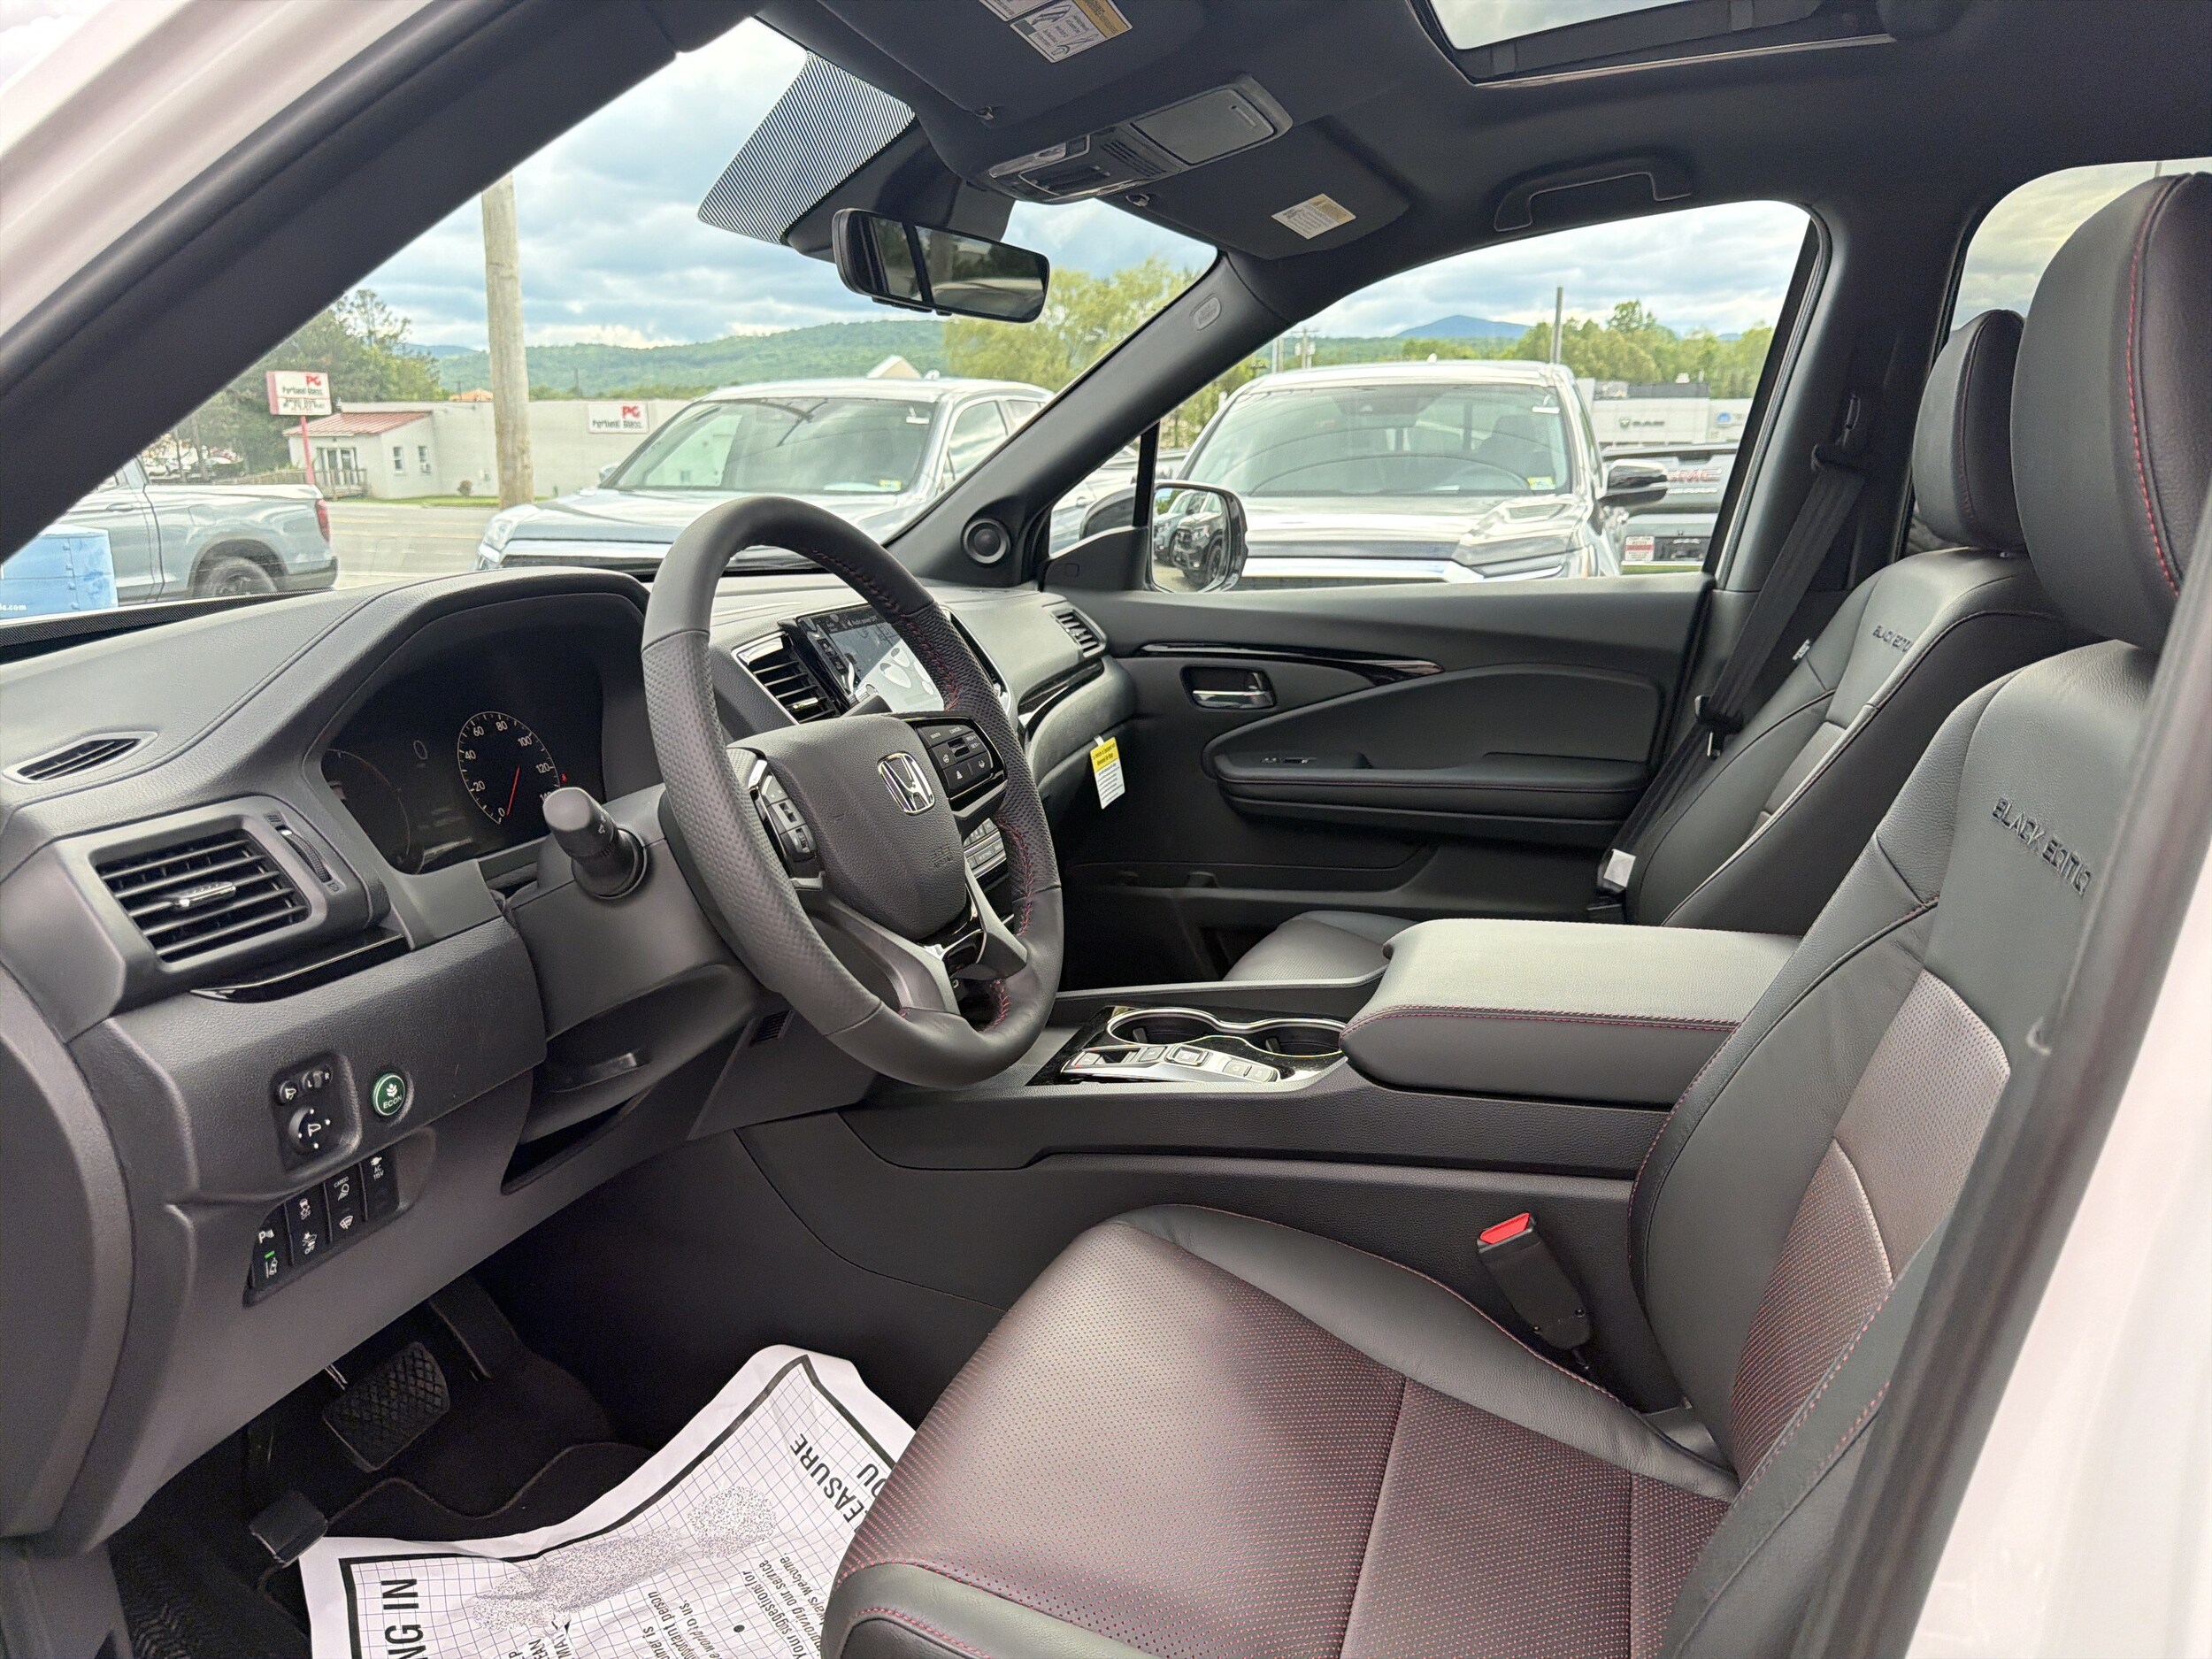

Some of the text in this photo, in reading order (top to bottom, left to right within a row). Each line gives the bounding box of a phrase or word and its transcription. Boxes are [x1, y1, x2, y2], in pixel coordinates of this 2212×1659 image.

[305, 375, 321, 387] PG
[622, 406, 640, 419] PG
[472, 726, 485, 737] 60
[495, 720, 508, 732] 80
[518, 735, 532, 747] 100
[465, 749, 477, 760] 40
[535, 762, 550, 774] 120
[472, 780, 486, 792] 20
[497, 807, 505, 818] 0
[1992, 797, 2045, 846] BLACK
[383, 1095, 402, 1109] ECON
[373, 1170, 384, 1180] 115V
[334, 1176, 349, 1188] CARGO
[304, 1244, 315, 1255] OFF
[790, 1433, 867, 1532] EASURE
[780, 1553, 812, 1596] welcome.
[380, 1578, 419, 1610] IN
[648, 1591, 676, 1622] person
[679, 1600, 693, 1616] us.
[759, 1560, 821, 1653] mproving our service
[743, 1571, 807, 1659] Your suggestions for
[642, 1626, 656, 1639] is
[554, 1633, 572, 1659] MAT
[689, 1631, 715, 1652] world
